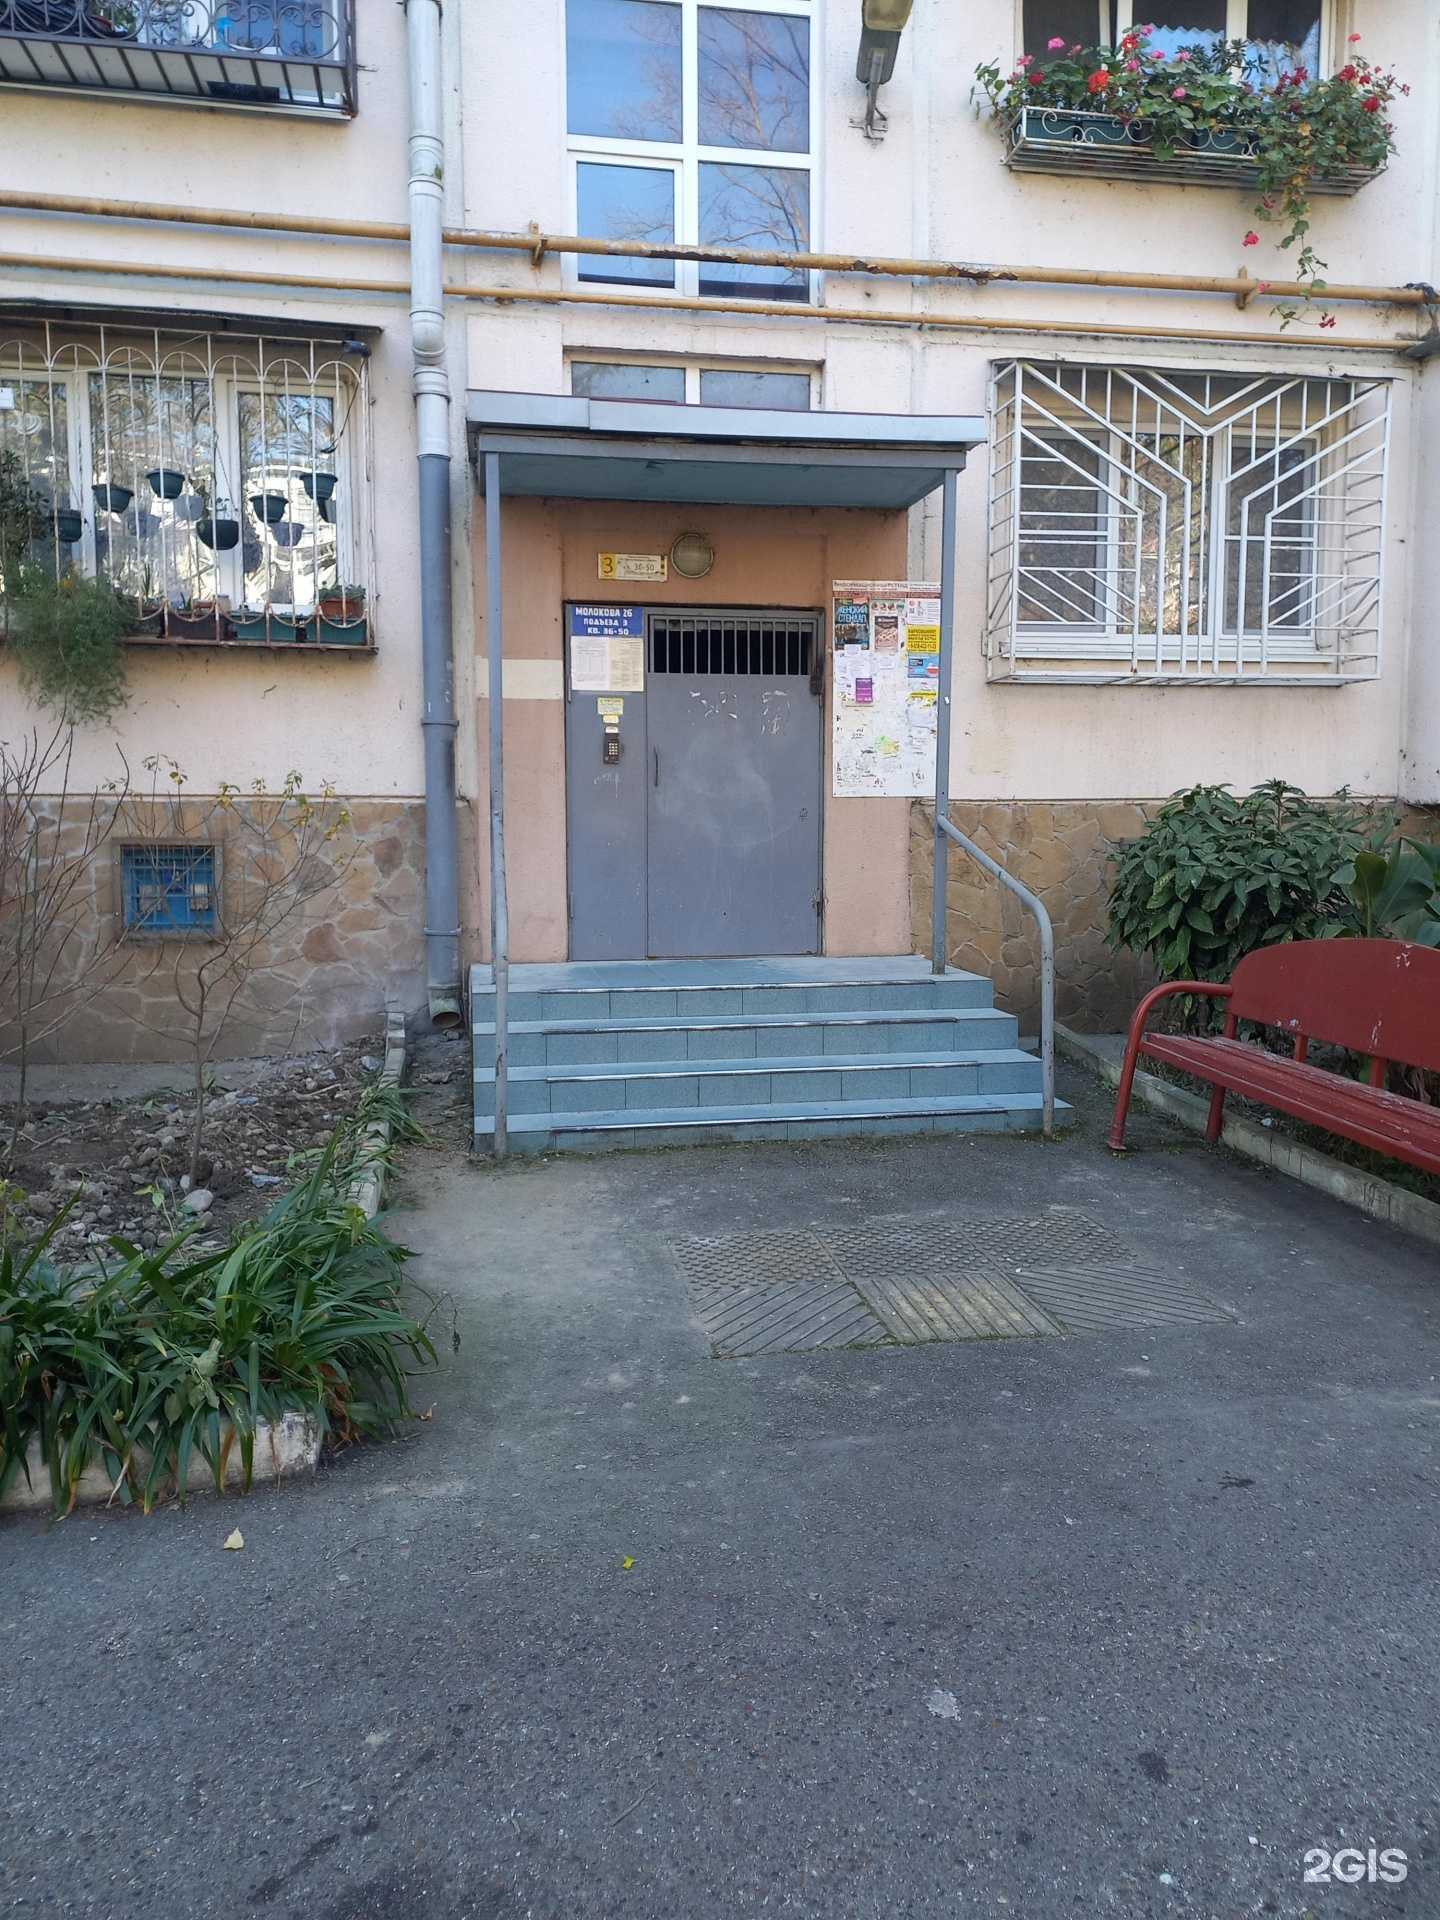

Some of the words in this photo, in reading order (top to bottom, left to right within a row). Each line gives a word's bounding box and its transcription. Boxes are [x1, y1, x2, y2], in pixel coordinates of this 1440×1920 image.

[603, 557, 614, 574] 3
[575, 606, 621, 617] МОЛОКОВА
[623, 608, 633, 618] 26
[622, 619, 629, 627] 3
[603, 627, 630, 635] 36-50
